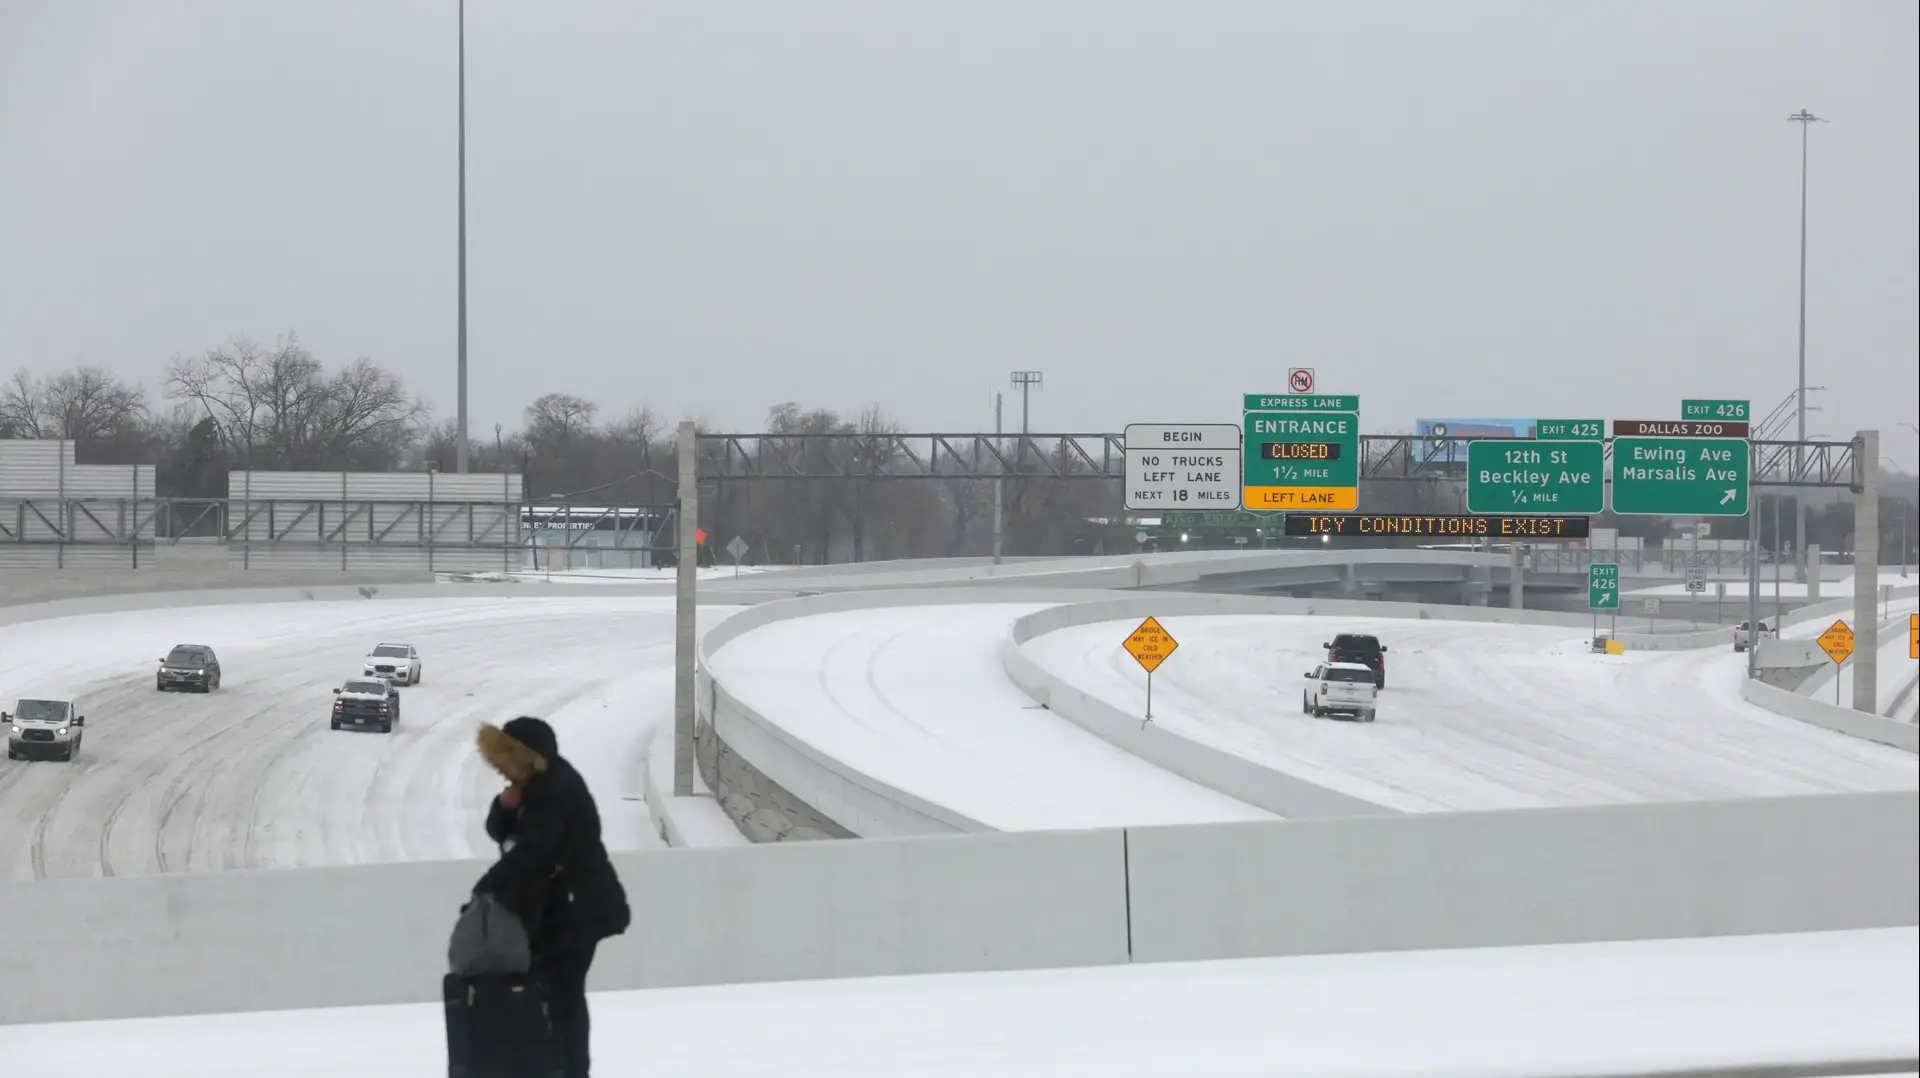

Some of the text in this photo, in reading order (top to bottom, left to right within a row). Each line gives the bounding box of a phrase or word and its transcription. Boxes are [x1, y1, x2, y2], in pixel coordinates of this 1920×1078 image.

[1261, 398, 1342, 407] EXPRESS LANE
[1687, 405, 1744, 417] EXIT 426
[1255, 420, 1347, 434] ENTRANCE
[1542, 424, 1599, 436] EXIT 425
[1639, 423, 1723, 435] DALLAS ZOO
[1163, 432, 1202, 441] BEGIN
[1272, 444, 1328, 458] CLOSED
[1505, 450, 1567, 464] 12th St
[1634, 447, 1731, 463] Ewing Ave
[1142, 457, 1223, 466] NO TRUCKS
[1144, 472, 1221, 482] LEFT LANE
[1304, 469, 1329, 477] MILE
[1480, 470, 1590, 486] Beckley Ave
[1623, 467, 1737, 481] Marsalis Ave
[1135, 490, 1229, 501] NEXT 18 MILES
[1264, 493, 1335, 503] LEFT LANE
[1533, 493, 1558, 502] MILE
[1310, 517, 1564, 534] ICY CONDITIONS EXIST
[1592, 579, 1615, 589] 426
